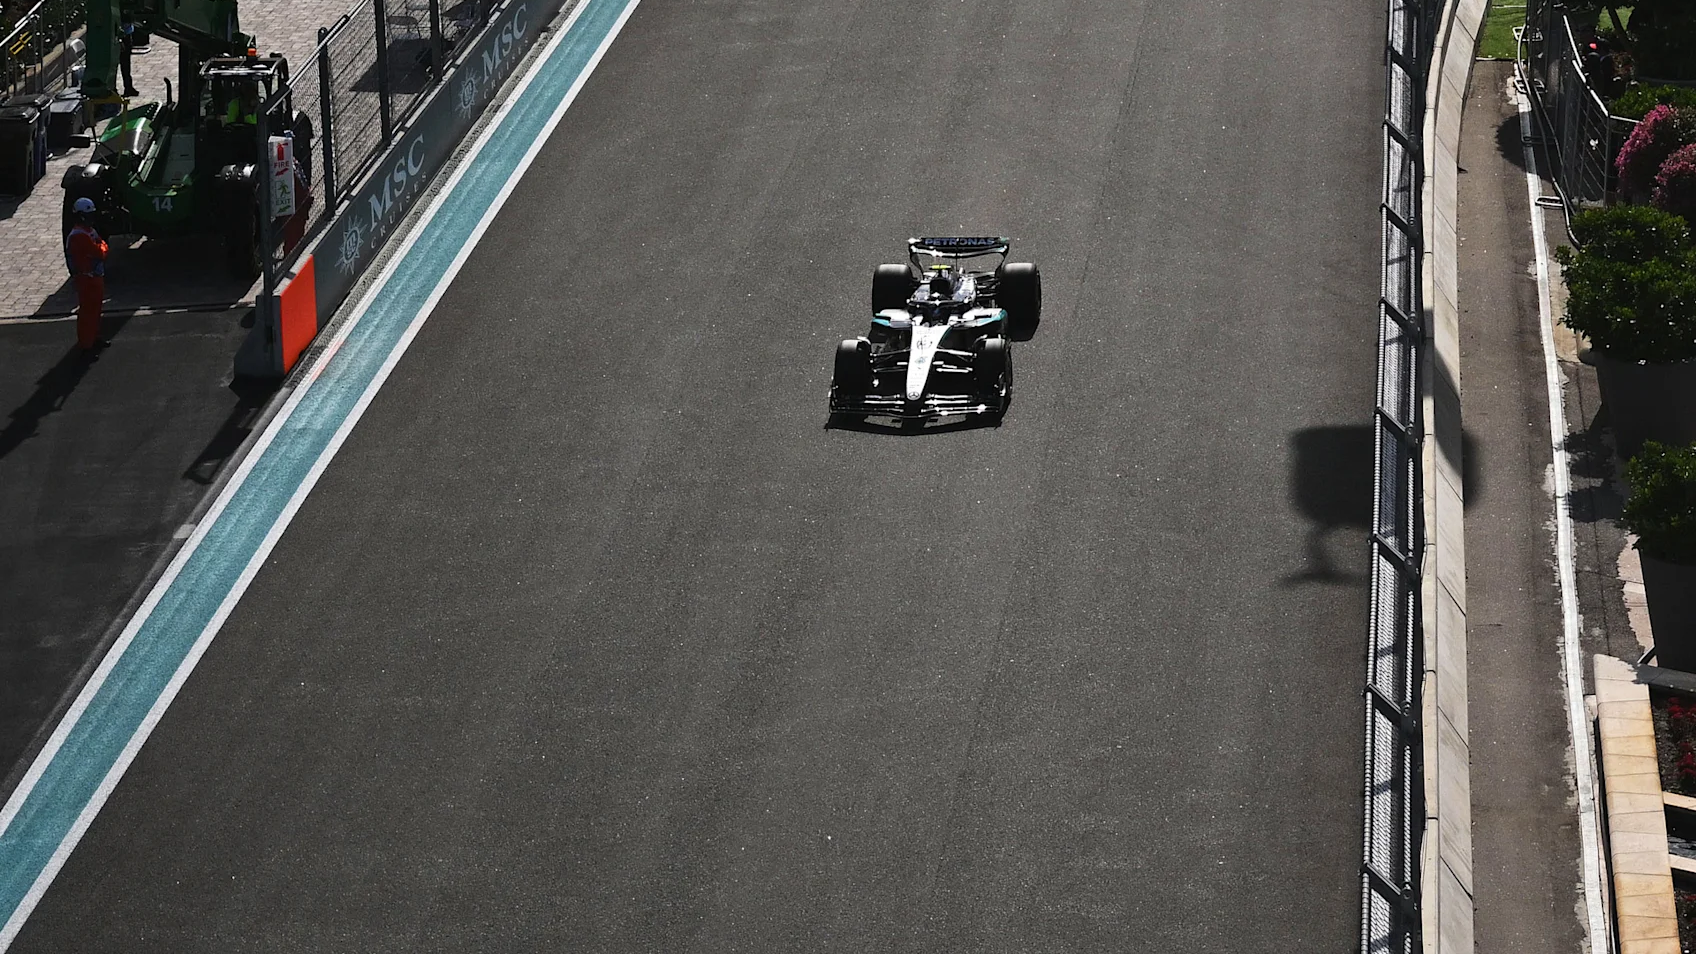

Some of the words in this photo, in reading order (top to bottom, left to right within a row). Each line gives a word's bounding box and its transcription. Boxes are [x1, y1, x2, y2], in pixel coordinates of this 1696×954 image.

[481, 2, 528, 85] MSC
[273, 161, 290, 169] FIRE
[367, 132, 426, 233] MSC
[152, 196, 174, 213] 14
[275, 198, 291, 206] EXIT
[370, 171, 428, 249] CRUISES
[924, 237, 996, 246] PETRONAS
